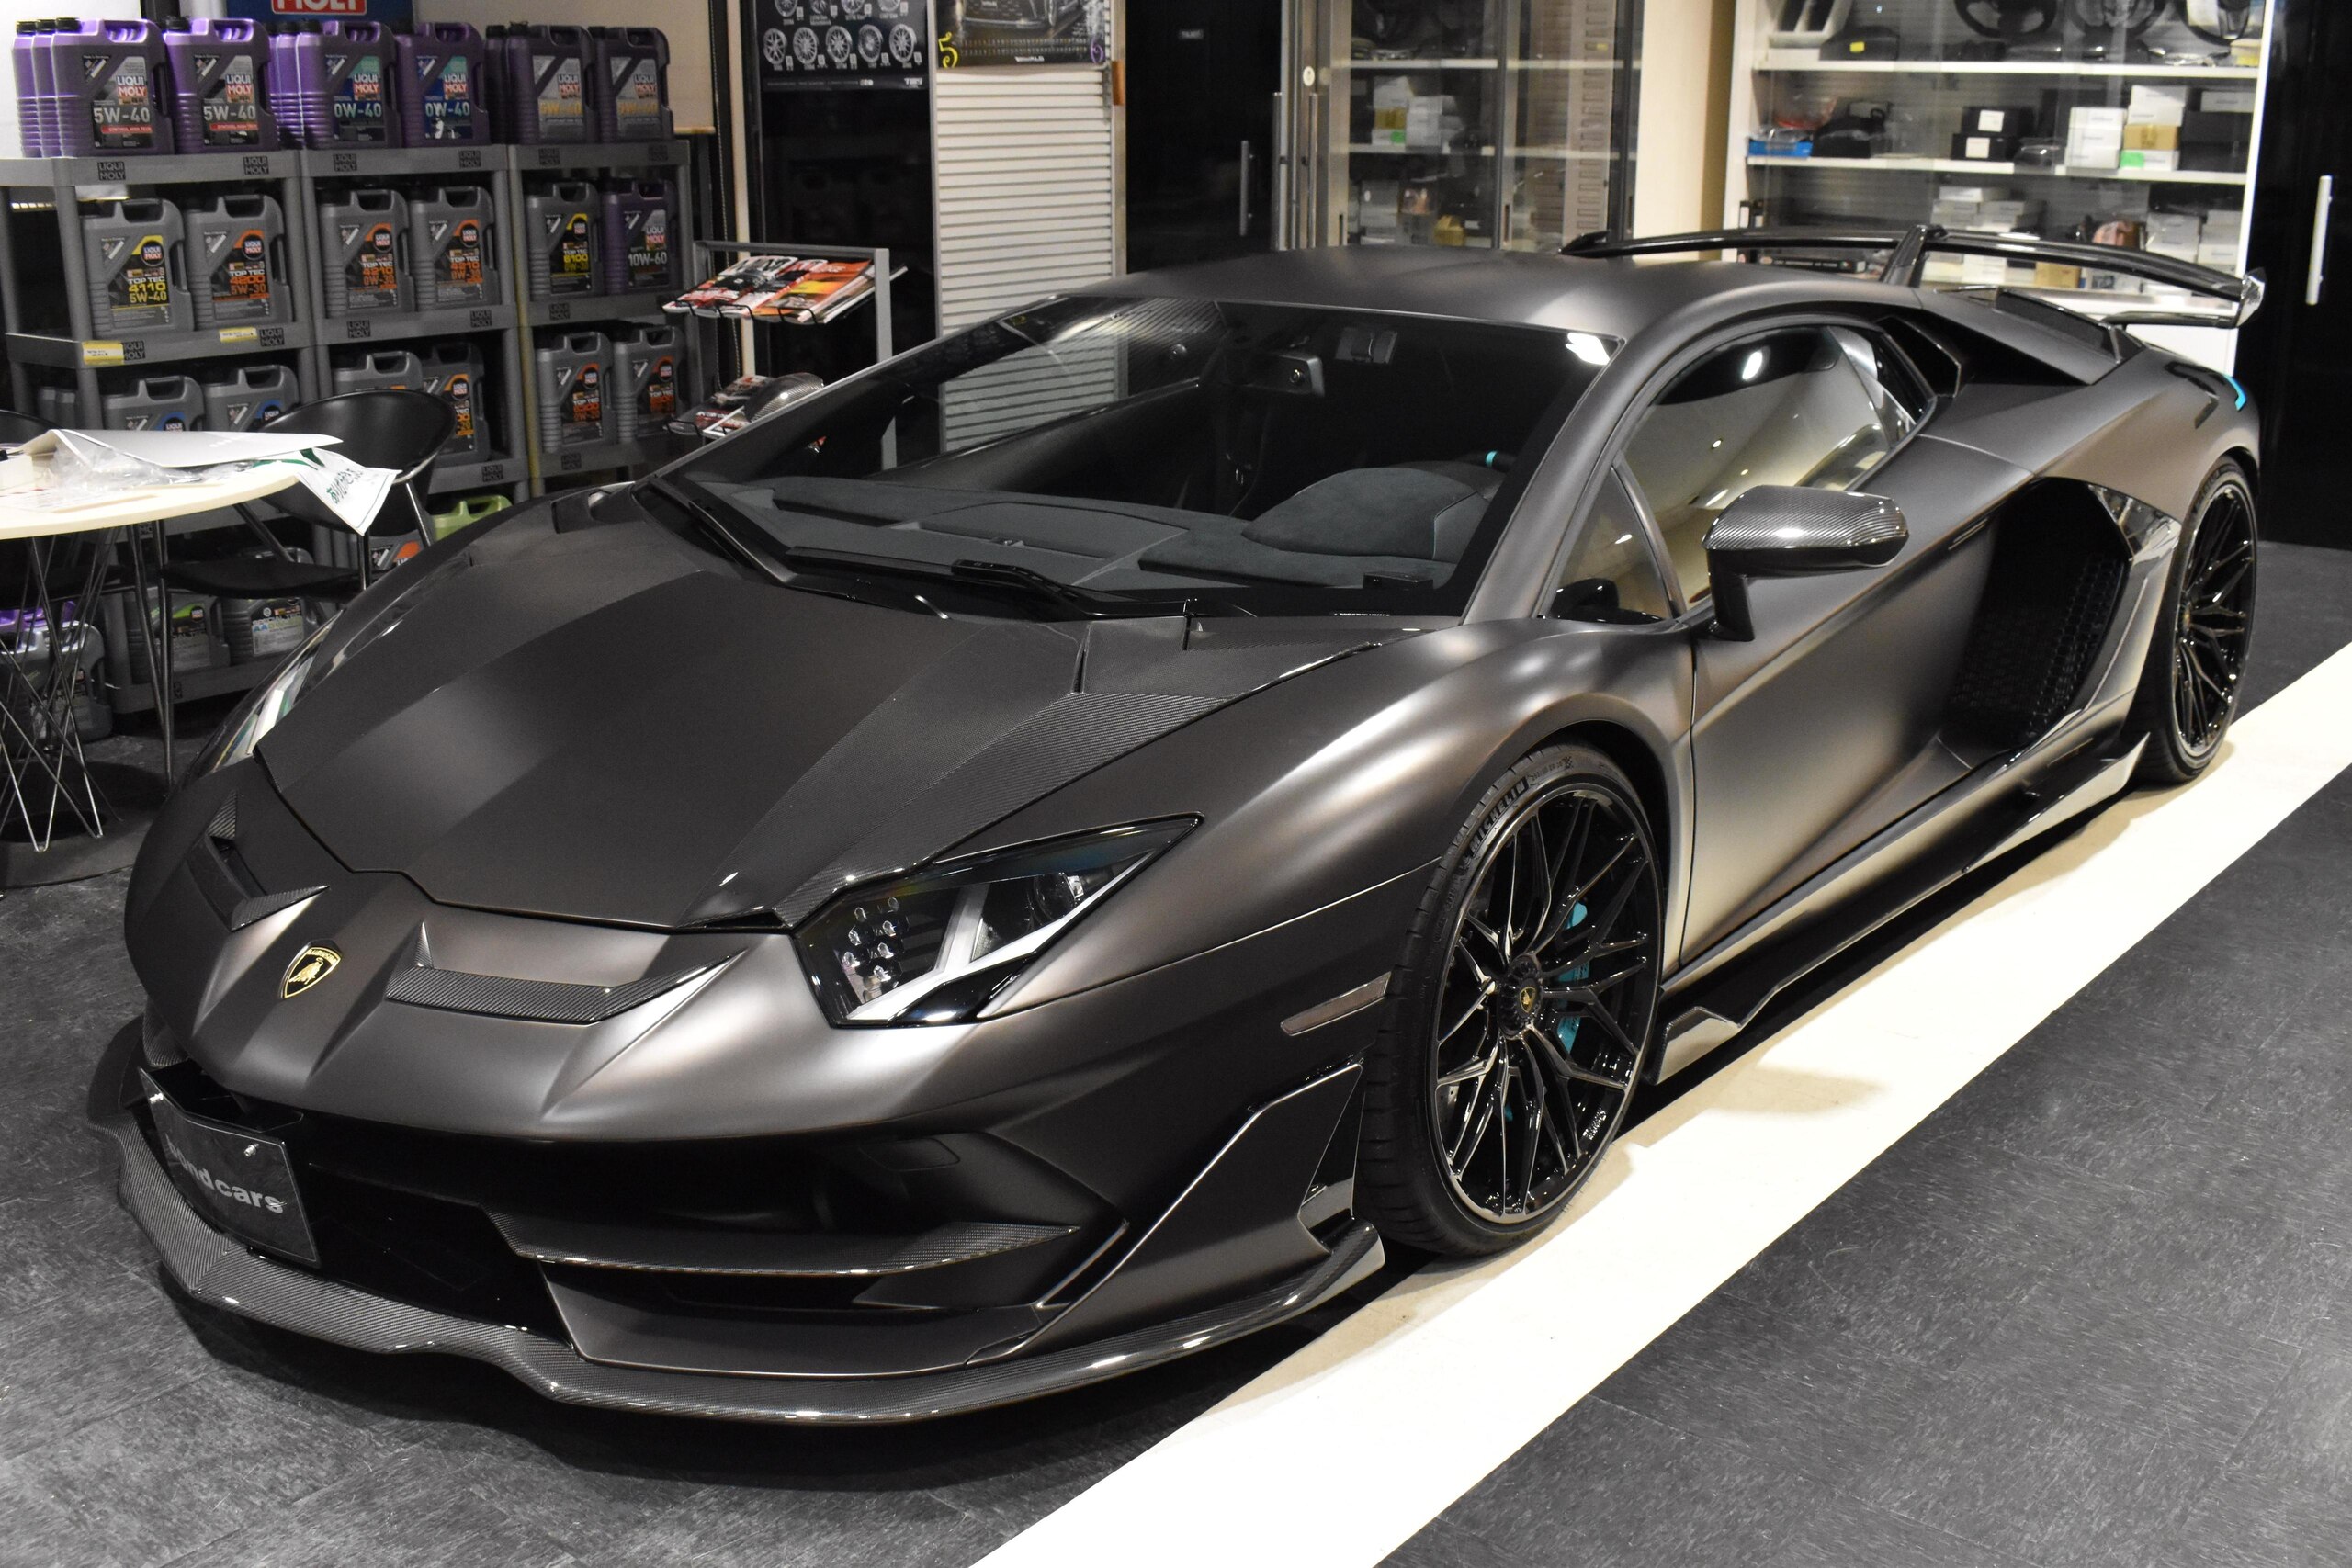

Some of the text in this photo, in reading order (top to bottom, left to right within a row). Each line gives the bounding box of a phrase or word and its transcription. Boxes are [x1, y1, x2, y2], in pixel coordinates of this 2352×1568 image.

[117, 76, 145, 86] LIQUI
[226, 74, 252, 85] LIQUI
[354, 73, 379, 83] LIQUI
[444, 73, 467, 83] LIQUI
[559, 74, 579, 83] LIQUI
[119, 87, 145, 96] MOLY
[227, 85, 252, 95] MOLY
[355, 83, 379, 93] MOLY
[445, 83, 467, 93] MOLY
[559, 84, 581, 94] MOLY
[636, 84, 656, 93] MOLY
[203, 105, 256, 121] 5W-40
[334, 103, 382, 118] 0W-40
[425, 102, 470, 117] 0W-40
[94, 107, 151, 124] 5W-40
[244, 157, 267, 166] LIQUI
[334, 154, 356, 164] LIQUI
[98, 162, 125, 171] LIQUI
[245, 166, 268, 175] MOLY
[334, 164, 356, 172] MOLY
[99, 171, 126, 181] MOLY
[647, 234, 665, 243] MOLY
[628, 251, 667, 266] 10W-60
[230, 276, 266, 285] 4200
[128, 283, 166, 292] 4110
[231, 284, 266, 295] 5W-30
[130, 291, 167, 303] 5W-40
[261, 329, 283, 338] LIQUI
[349, 330, 371, 338] MOLY
[262, 338, 284, 347] MOLY
[1469, 781, 1526, 854] MICHELIN
